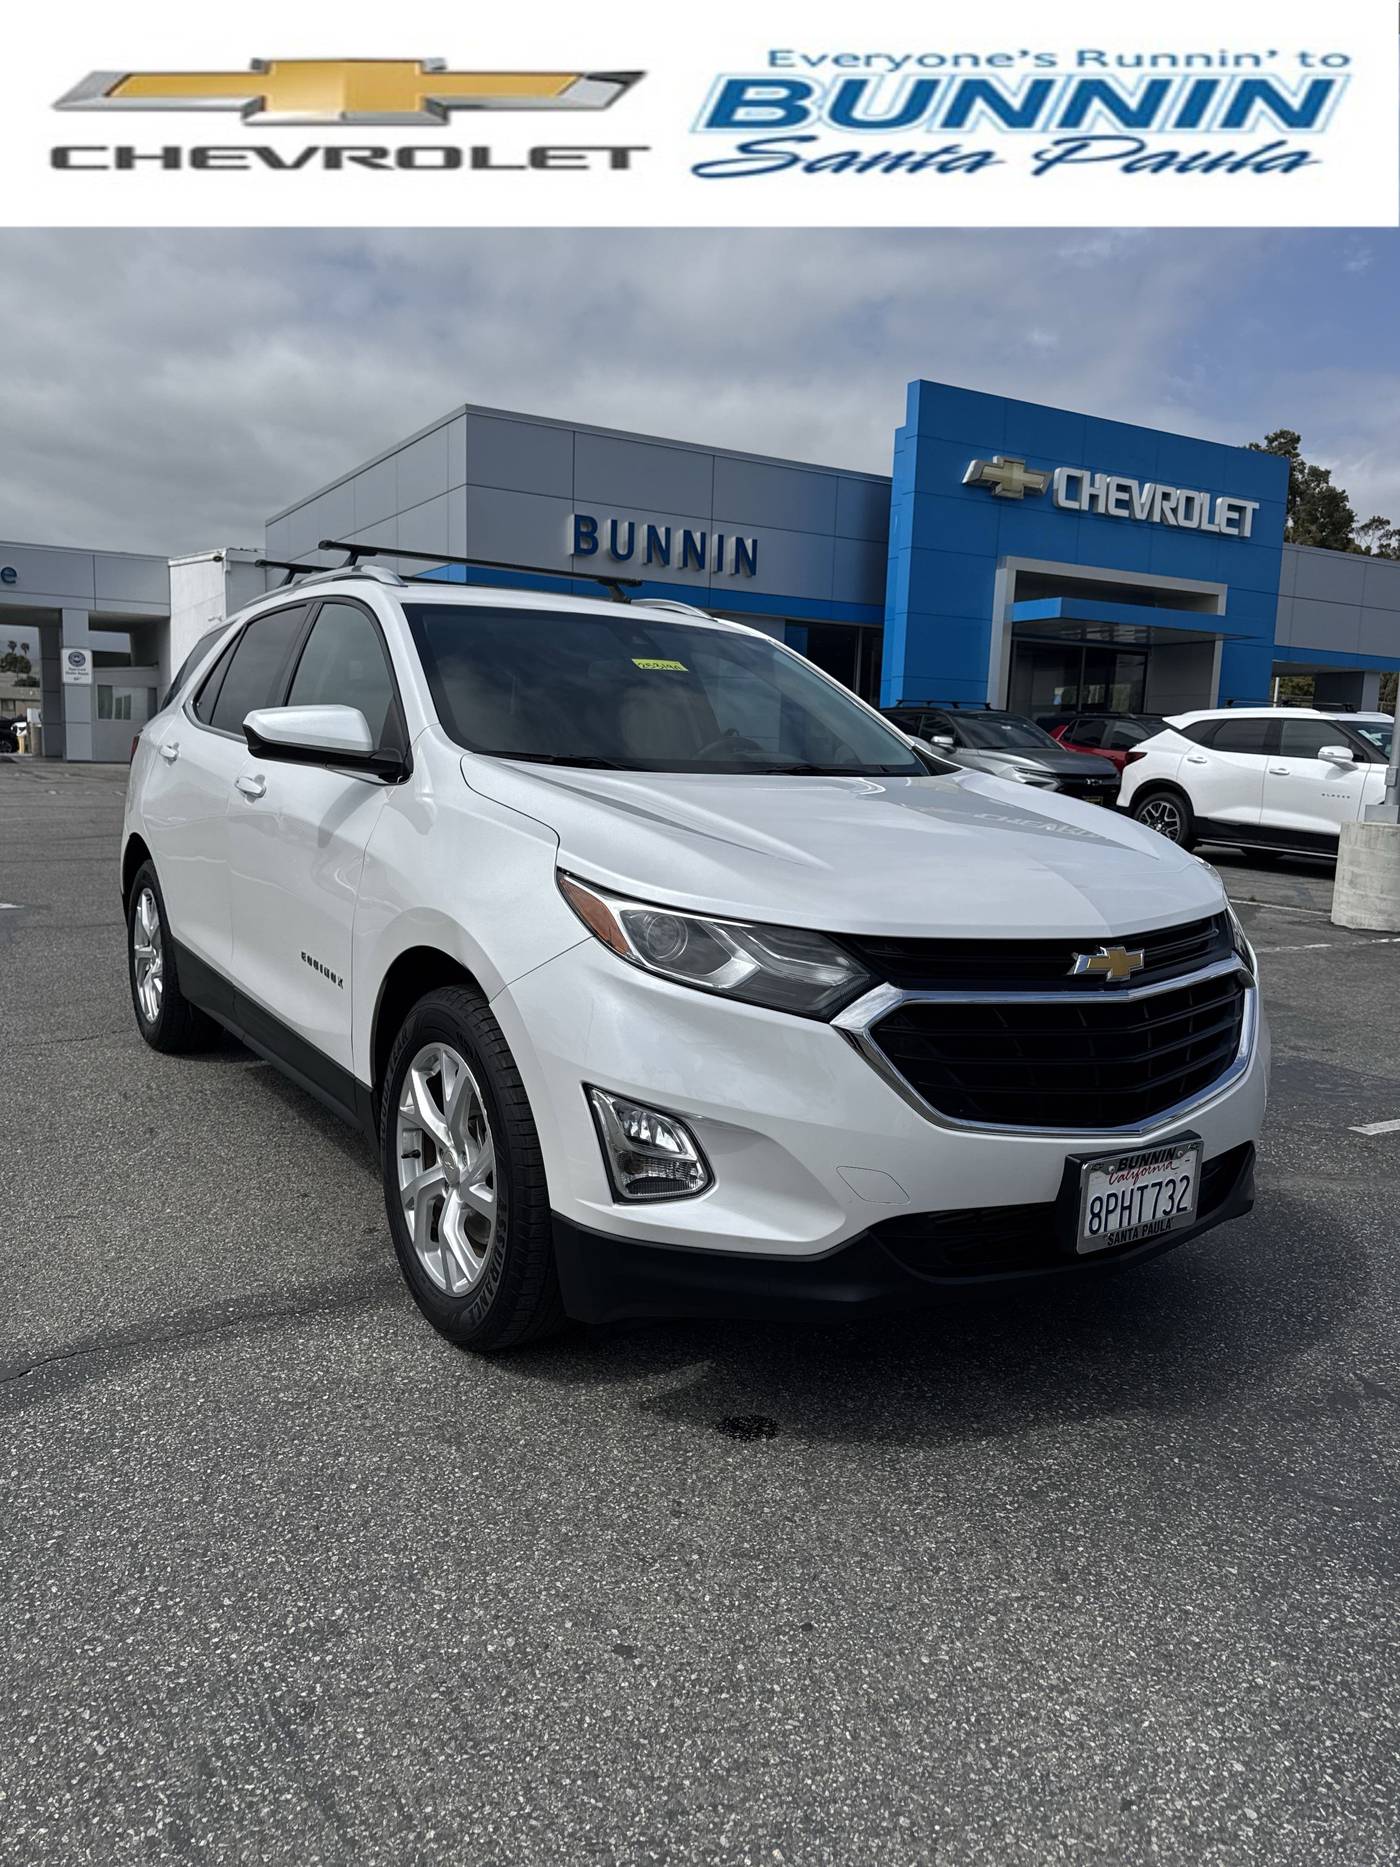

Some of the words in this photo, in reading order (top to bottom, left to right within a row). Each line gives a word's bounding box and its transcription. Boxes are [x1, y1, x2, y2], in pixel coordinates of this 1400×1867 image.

[1053, 467, 1259, 537] CHEVROLET
[570, 514, 758, 576] BUNNIN
[300, 951, 344, 990] EQUINOX
[1108, 1161, 1180, 1186] California
[1117, 1147, 1177, 1170] BUNNIN
[1088, 1175, 1191, 1235] 8PHT732
[1107, 1227, 1139, 1246] SANTA
[1141, 1218, 1172, 1237] PAULA
